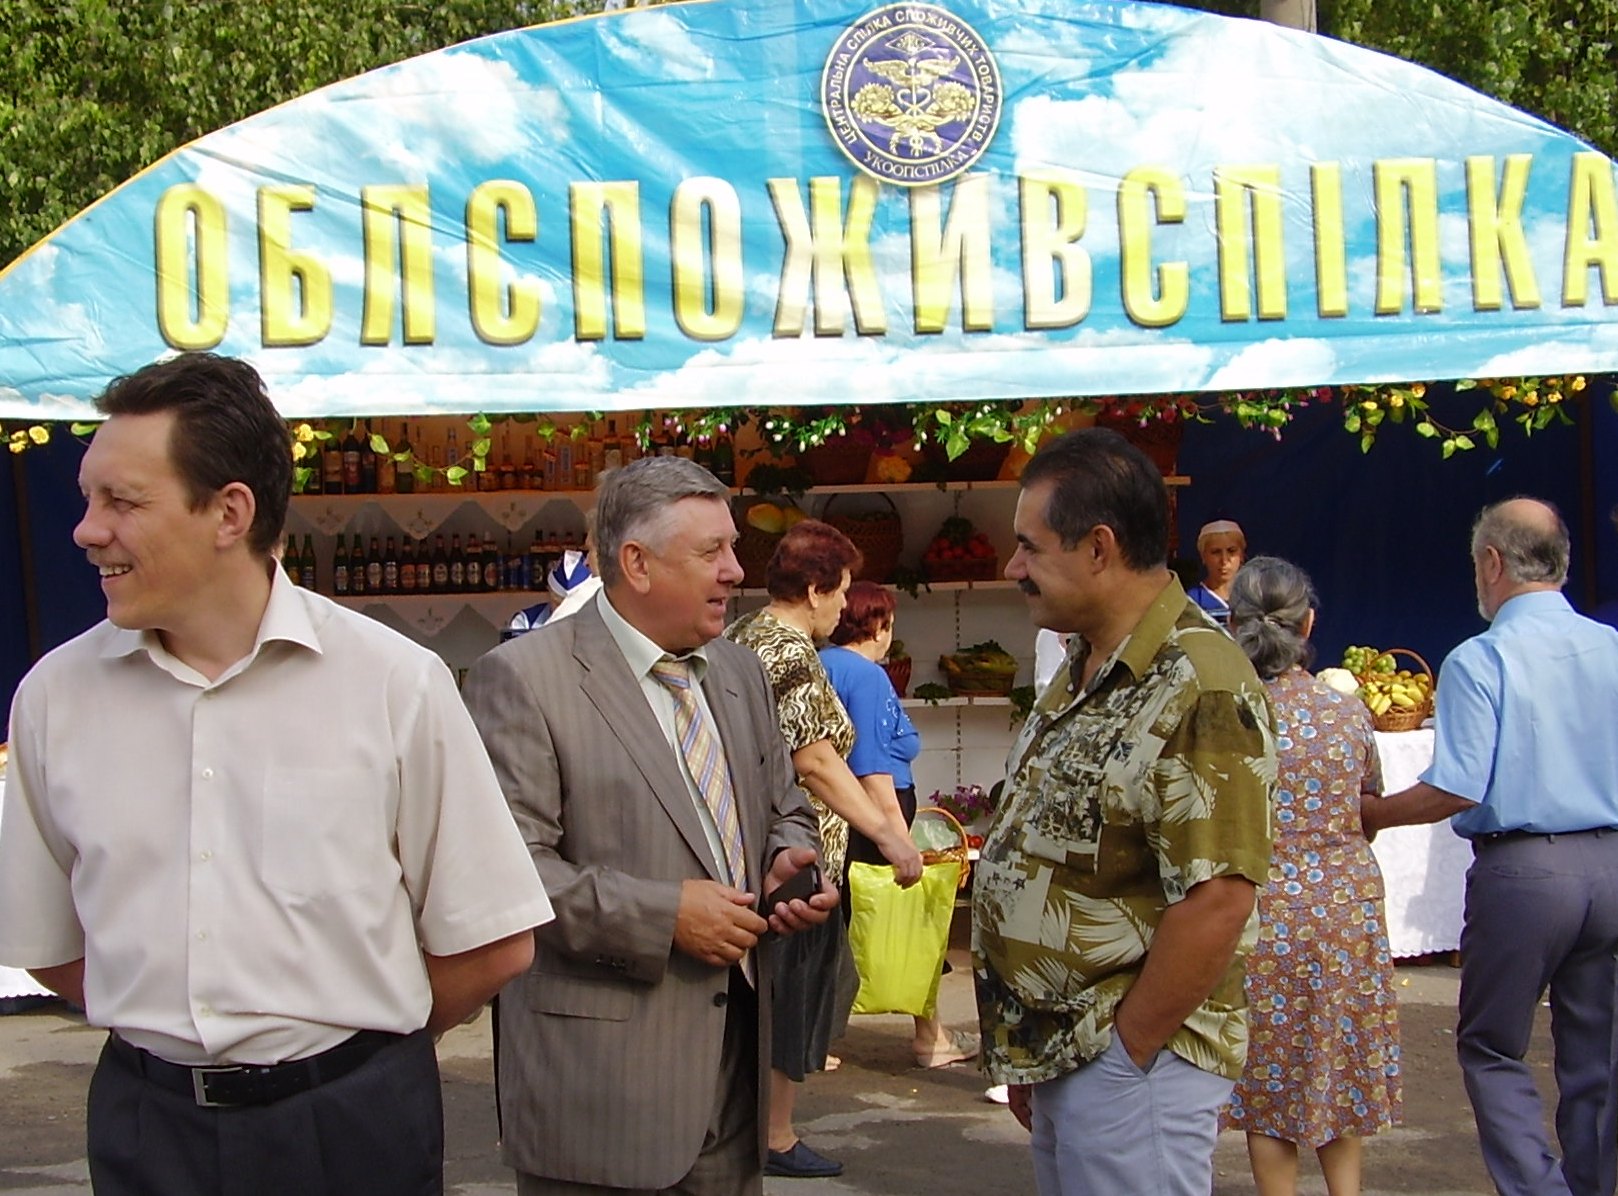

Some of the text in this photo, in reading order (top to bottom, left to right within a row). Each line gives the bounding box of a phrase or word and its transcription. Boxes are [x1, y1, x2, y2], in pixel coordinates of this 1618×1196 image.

[830, 9, 995, 145] ЦЕНТРАЛЬНА СПІЛКА СПОЖИВЧИХ ТОВАРИСТВ
[863, 149, 970, 179] УКООПСПІЛКА
[154, 152, 1618, 351] ОБЛСПОЖИВСПІЛКА
